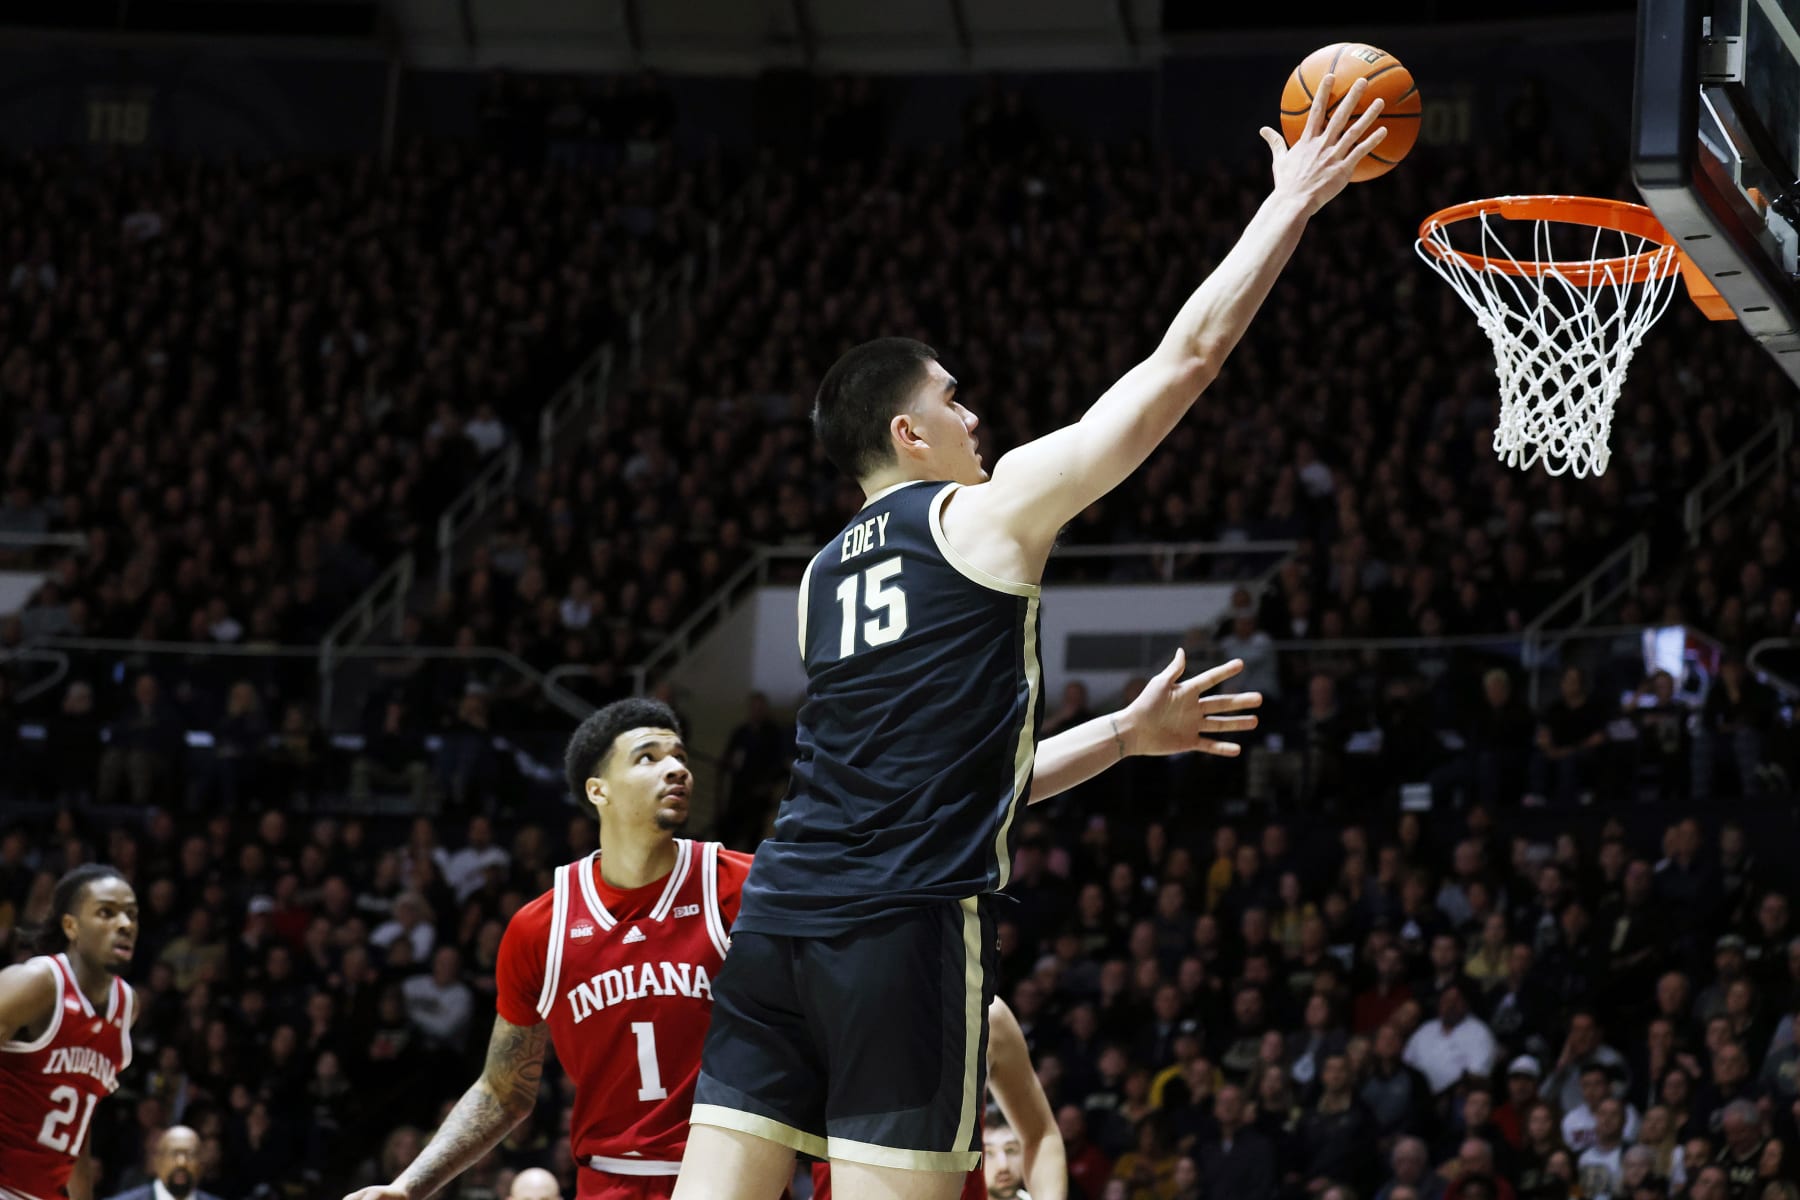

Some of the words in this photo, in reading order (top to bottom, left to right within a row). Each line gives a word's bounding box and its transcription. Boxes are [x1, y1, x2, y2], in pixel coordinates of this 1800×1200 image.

[840, 511, 891, 564] EDEY
[836, 556, 908, 660] 15
[567, 961, 716, 1025] INDIANA
[42, 1046, 120, 1094] INDIANA
[631, 1021, 668, 1102] 1
[37, 1084, 98, 1157] 21
